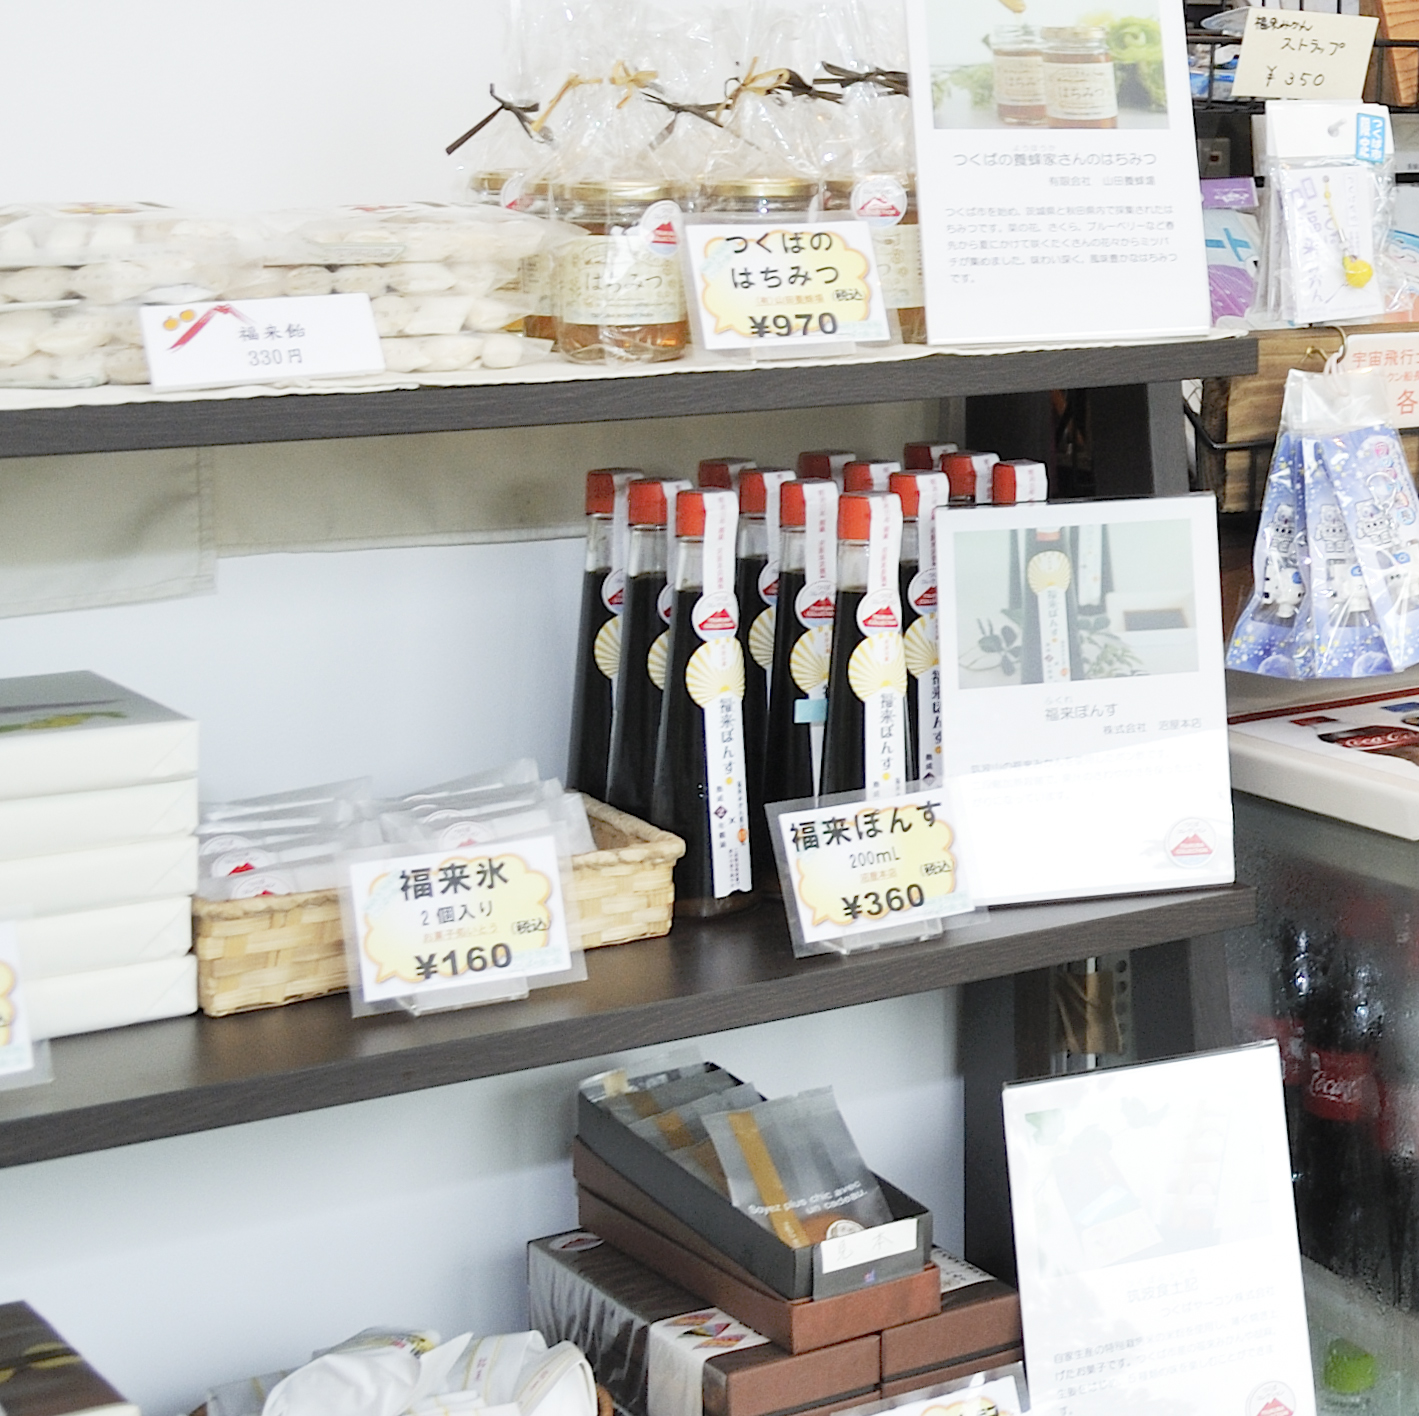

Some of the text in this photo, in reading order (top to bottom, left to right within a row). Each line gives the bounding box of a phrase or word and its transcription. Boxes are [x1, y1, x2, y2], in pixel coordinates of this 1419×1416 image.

[1280, 37, 1347, 57] ストラップ
[952, 151, 1158, 168] つくばの養蜂家さんのはちみつ
[725, 231, 834, 255] つくばの
[730, 264, 840, 290] はちみつ
[238, 322, 307, 343] 福来飴
[748, 311, 839, 338] ¥970
[1102, 722, 1148, 735] 株式会社
[849, 847, 902, 869] 200mL
[400, 858, 511, 902] 福来氷
[420, 900, 494, 926] 2個入り
[841, 882, 926, 920] ¥360
[414, 942, 514, 980] ¥160
[809, 1190, 833, 1204] chic
